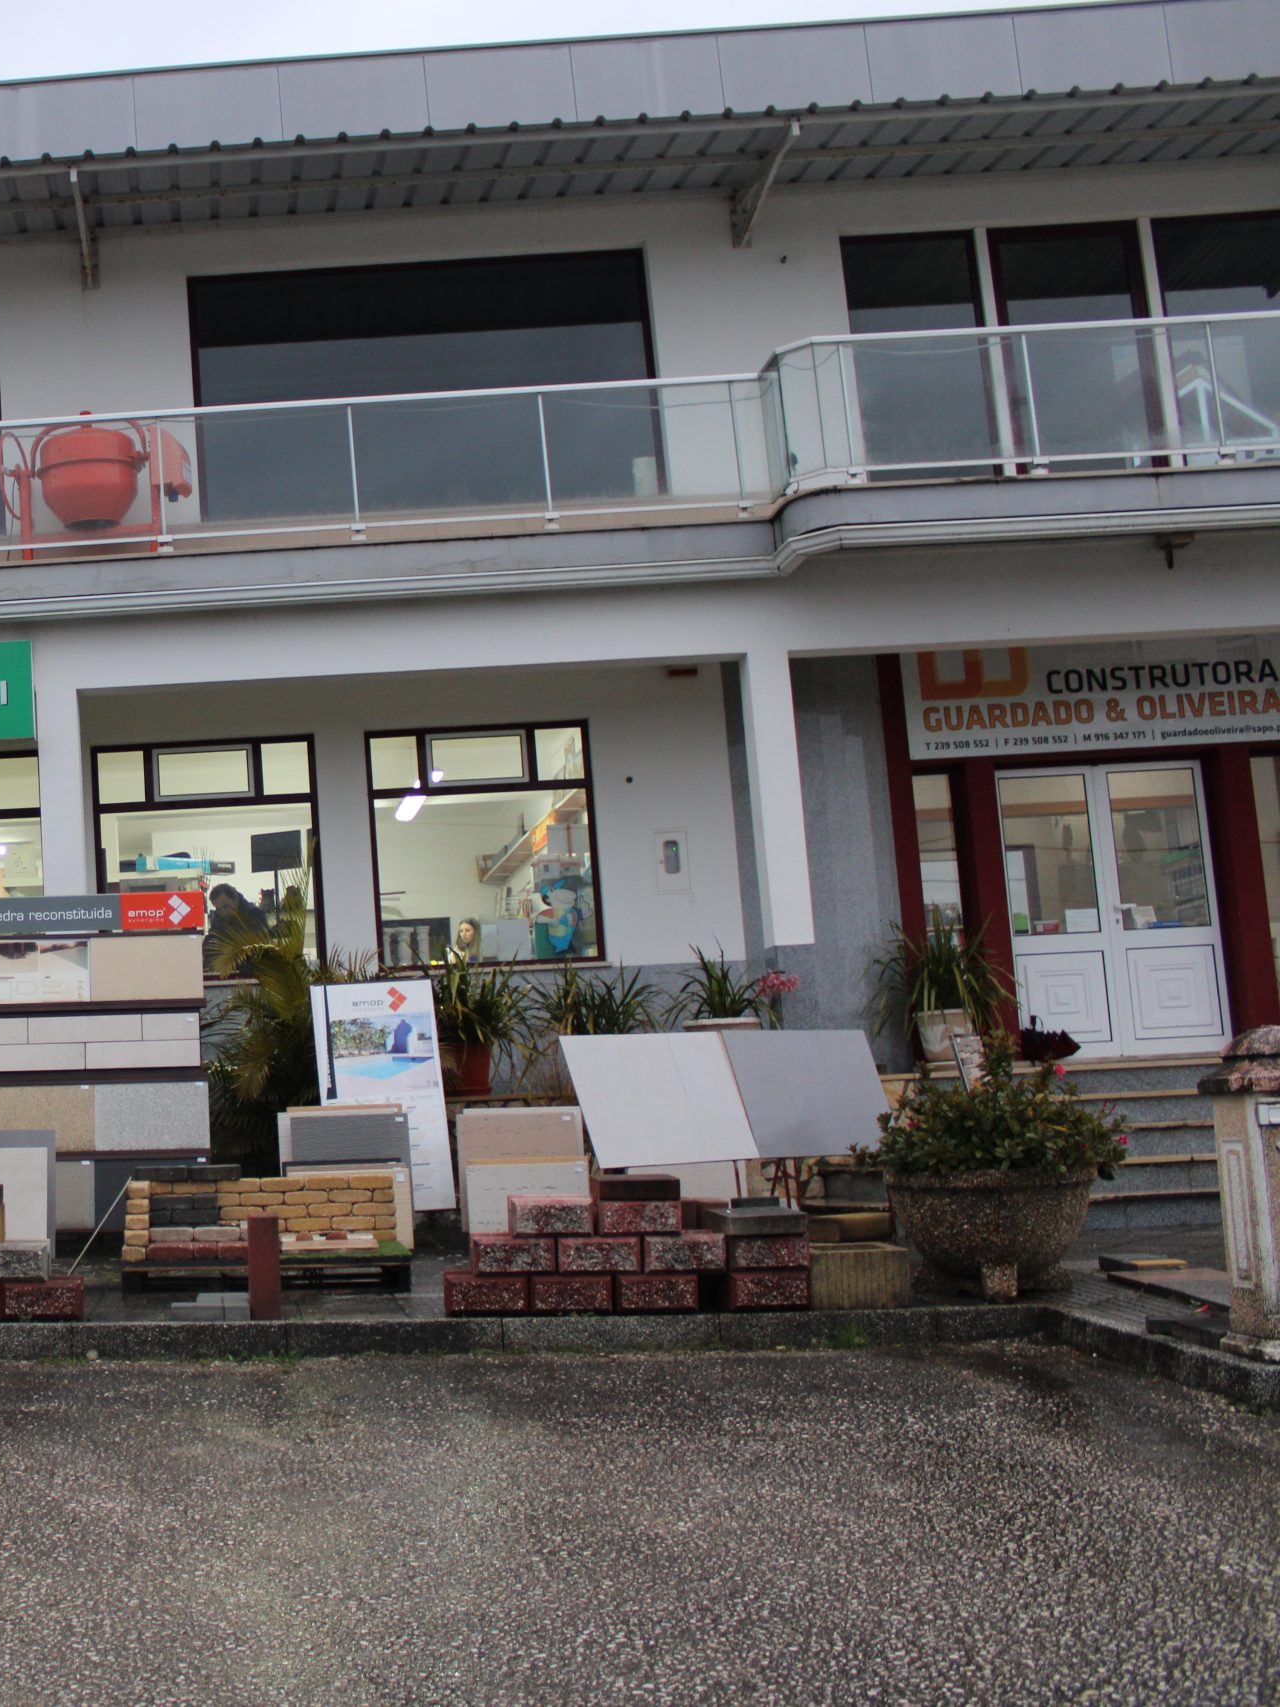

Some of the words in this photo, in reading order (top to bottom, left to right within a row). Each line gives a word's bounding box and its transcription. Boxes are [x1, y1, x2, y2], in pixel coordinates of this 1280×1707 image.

[1046, 659, 1279, 694] CONSTRUTORA
[922, 698, 1095, 732] GUARDADO
[1106, 698, 1128, 722] &
[1136, 688, 1280, 721] OLIVEIRA
[924, 742, 932, 750] T
[934, 741, 950, 750] 239
[953, 740, 970, 749] 508
[973, 739, 990, 748] 552
[1004, 738, 1010, 746] F
[1012, 736, 1029, 746] 239
[1032, 736, 1049, 745] 508
[1052, 734, 1069, 744] 552
[1083, 734, 1092, 742] M
[1094, 732, 1110, 742] 916
[1113, 732, 1129, 740] 347
[1132, 730, 1146, 740] 171
[28, 907, 112, 922] reconstituída
[128, 909, 164, 919] amop
[352, 1000, 384, 1008] amop
